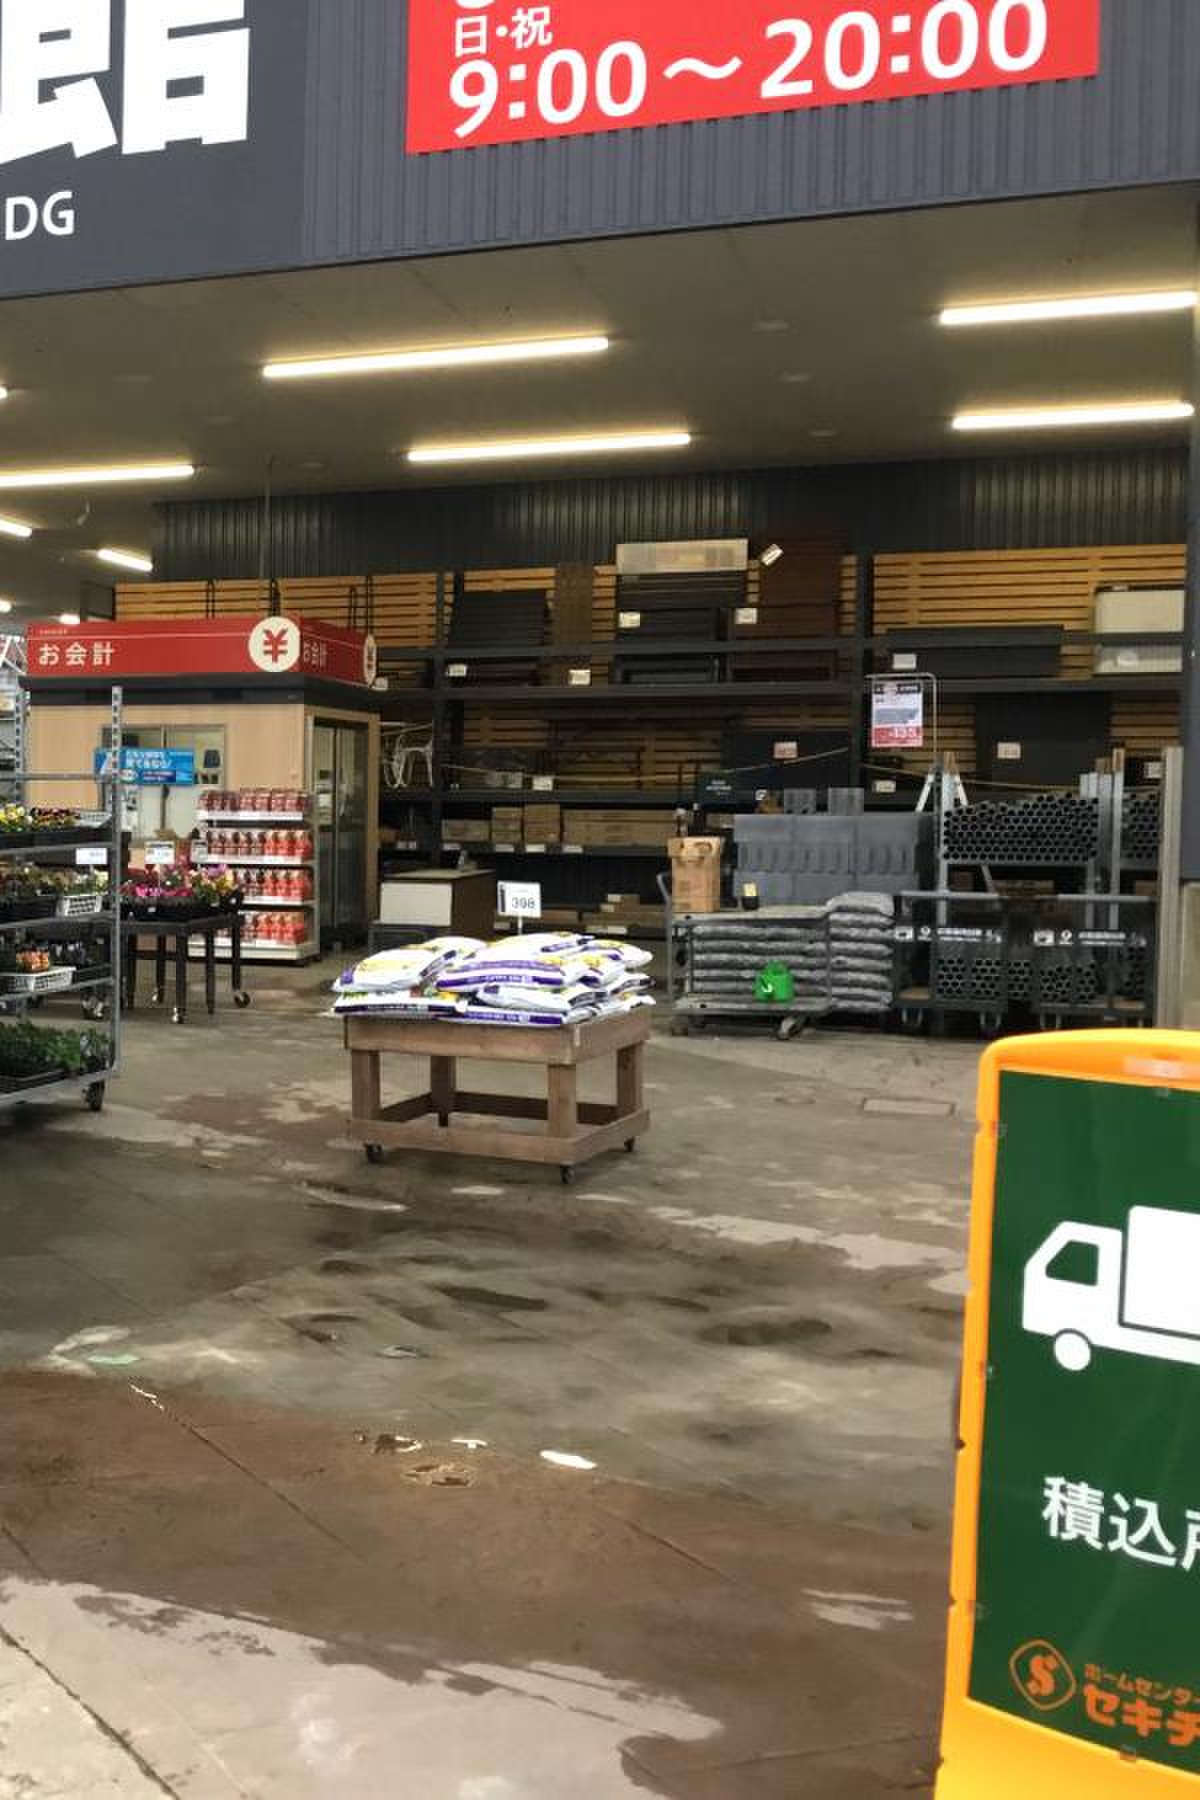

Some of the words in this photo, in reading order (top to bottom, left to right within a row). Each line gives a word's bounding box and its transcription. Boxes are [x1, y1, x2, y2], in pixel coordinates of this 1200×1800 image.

[39, 641, 115, 666] お会計
[1085, 1664, 1200, 1706] ホームセンタ
